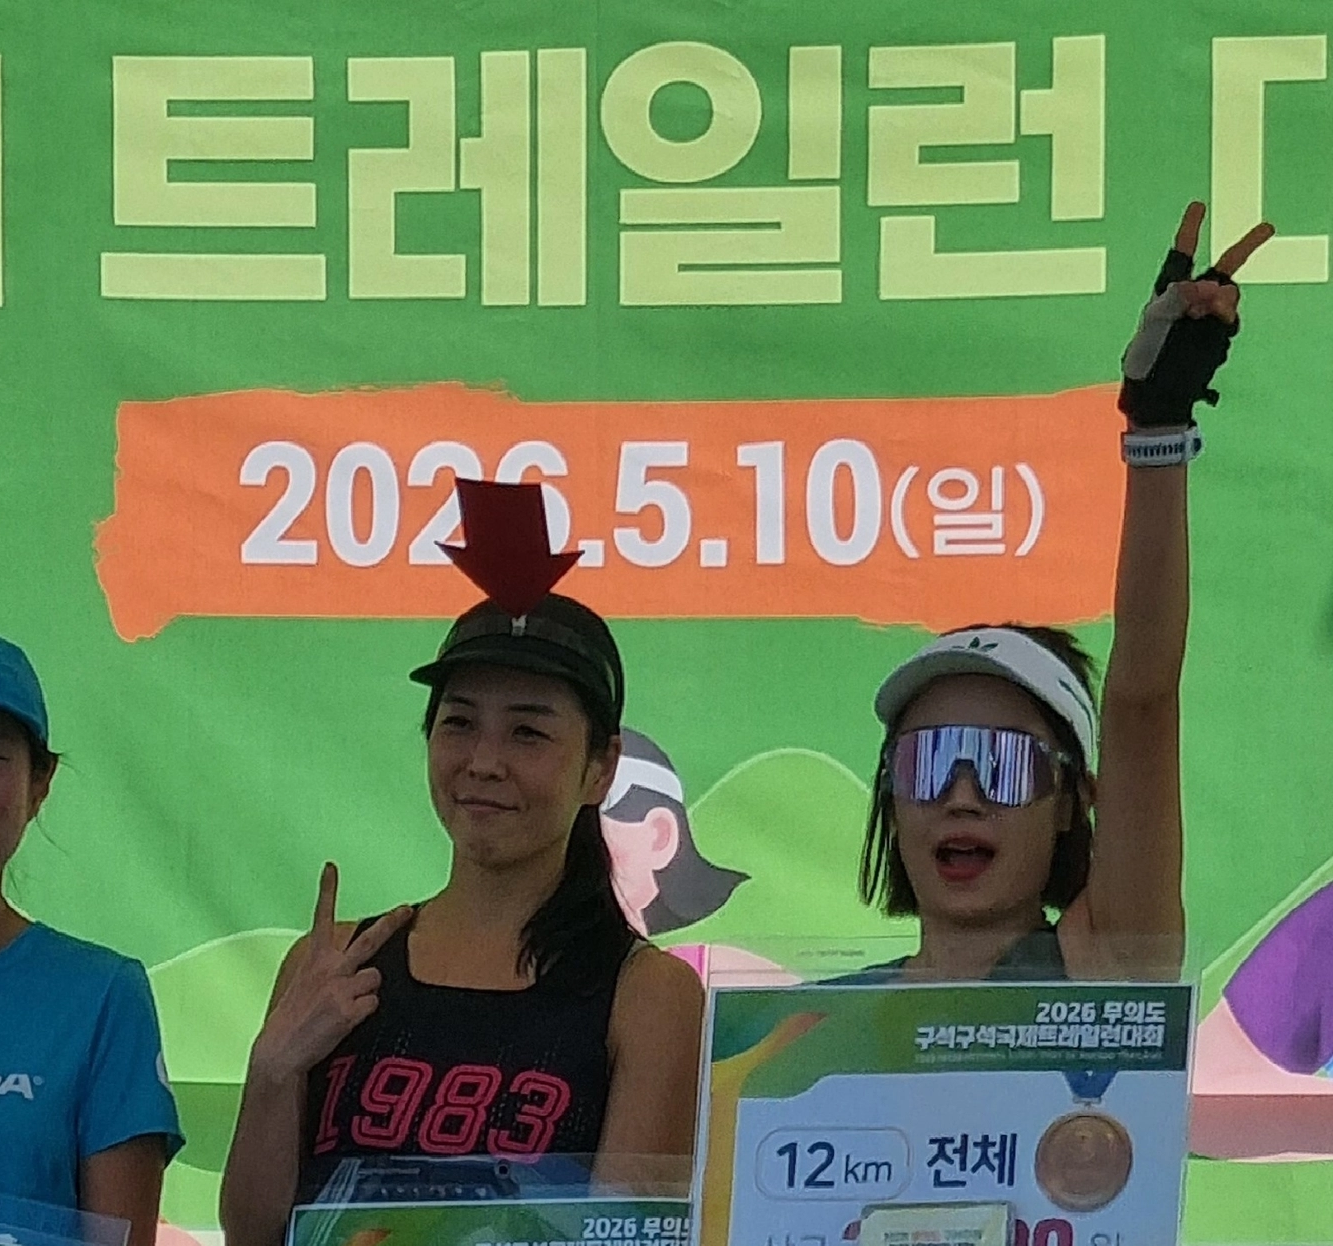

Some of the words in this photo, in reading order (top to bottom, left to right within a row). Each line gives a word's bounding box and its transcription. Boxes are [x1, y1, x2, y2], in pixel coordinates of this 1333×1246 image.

[100, 35, 1106, 306] 트레일런
[1035, 1001, 1096, 1023] 2026
[1102, 1000, 1166, 1024] 무의도
[313, 1055, 572, 1164] 1983
[776, 1140, 835, 1189] 12
[843, 1154, 892, 1184] km
[927, 1132, 1018, 1190] 전체
[583, 1218, 637, 1239] 2026
